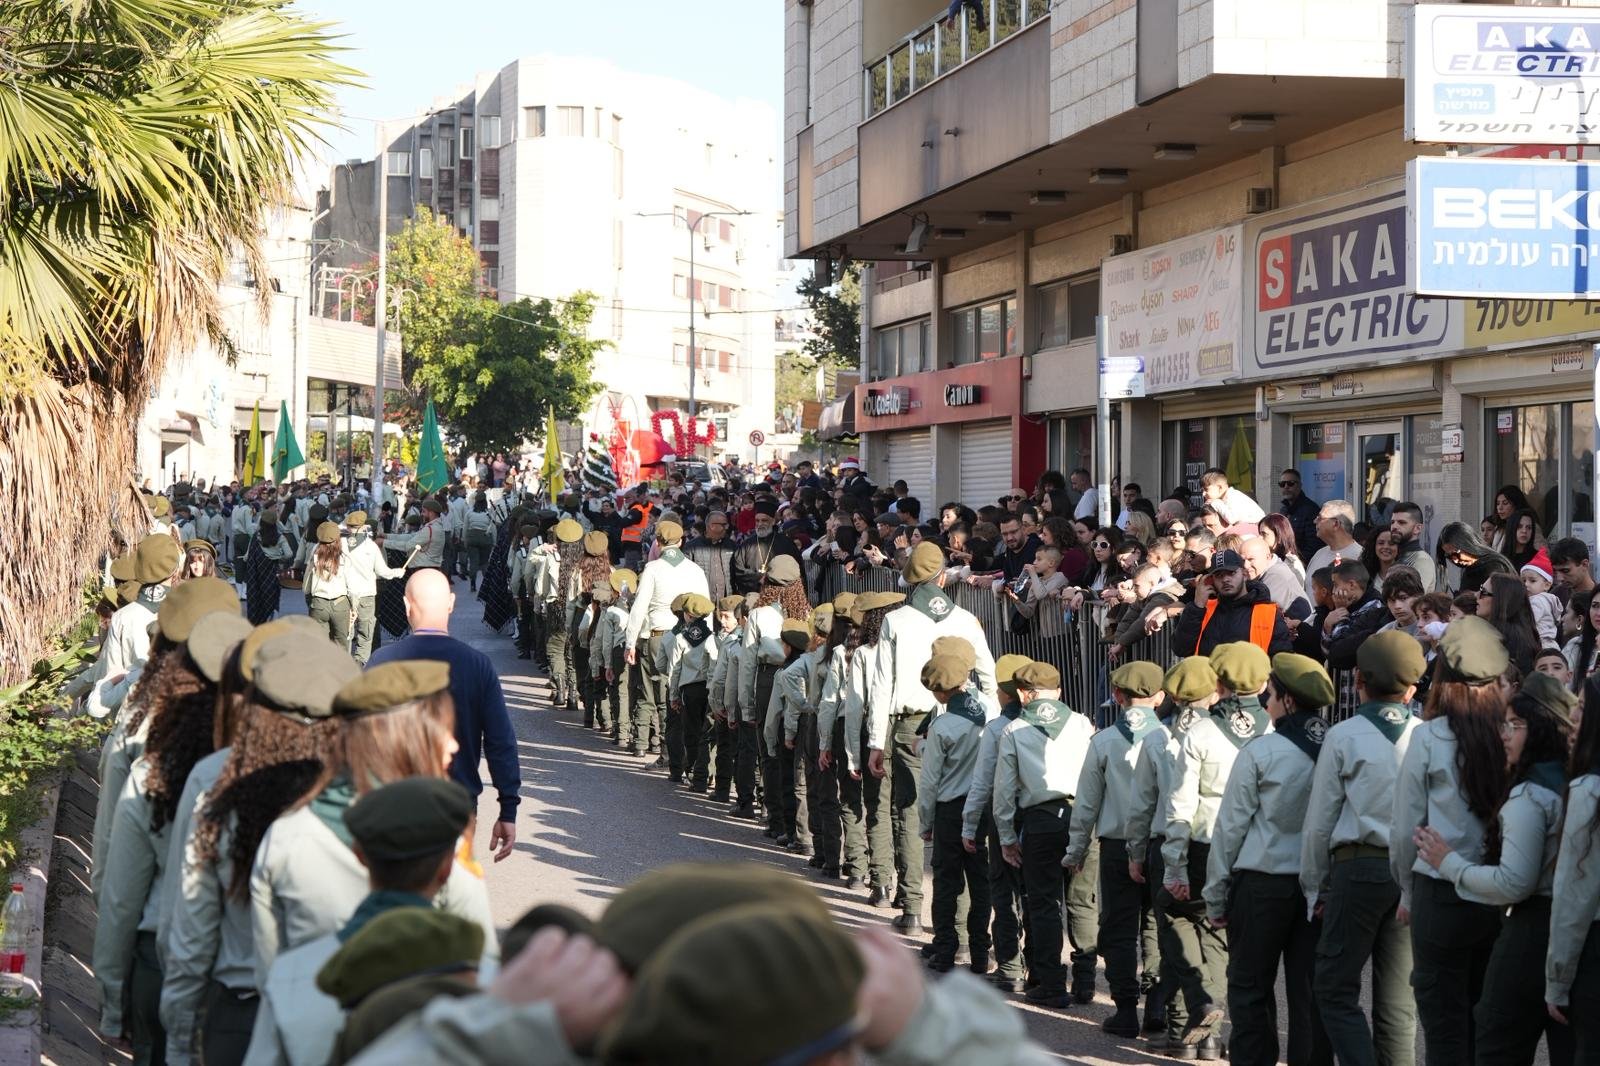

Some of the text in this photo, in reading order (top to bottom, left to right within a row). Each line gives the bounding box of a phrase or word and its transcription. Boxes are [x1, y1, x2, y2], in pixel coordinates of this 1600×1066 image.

[1439, 100, 1490, 111] מורשה
[1438, 120, 1533, 133] חשמל
[1107, 234, 1235, 287] SAMSUNG BOSCH SIEMENS LG
[1265, 223, 1396, 299] SAKA
[1433, 238, 1540, 266] עולמית
[1141, 290, 1164, 316] dyson
[1172, 285, 1199, 303] SHARP
[1119, 328, 1141, 350] Shark
[1178, 316, 1196, 337] NINJA
[1204, 311, 1220, 331] AEG
[1266, 293, 1431, 355] ELECTRIC
[943, 384, 975, 407] Canon
